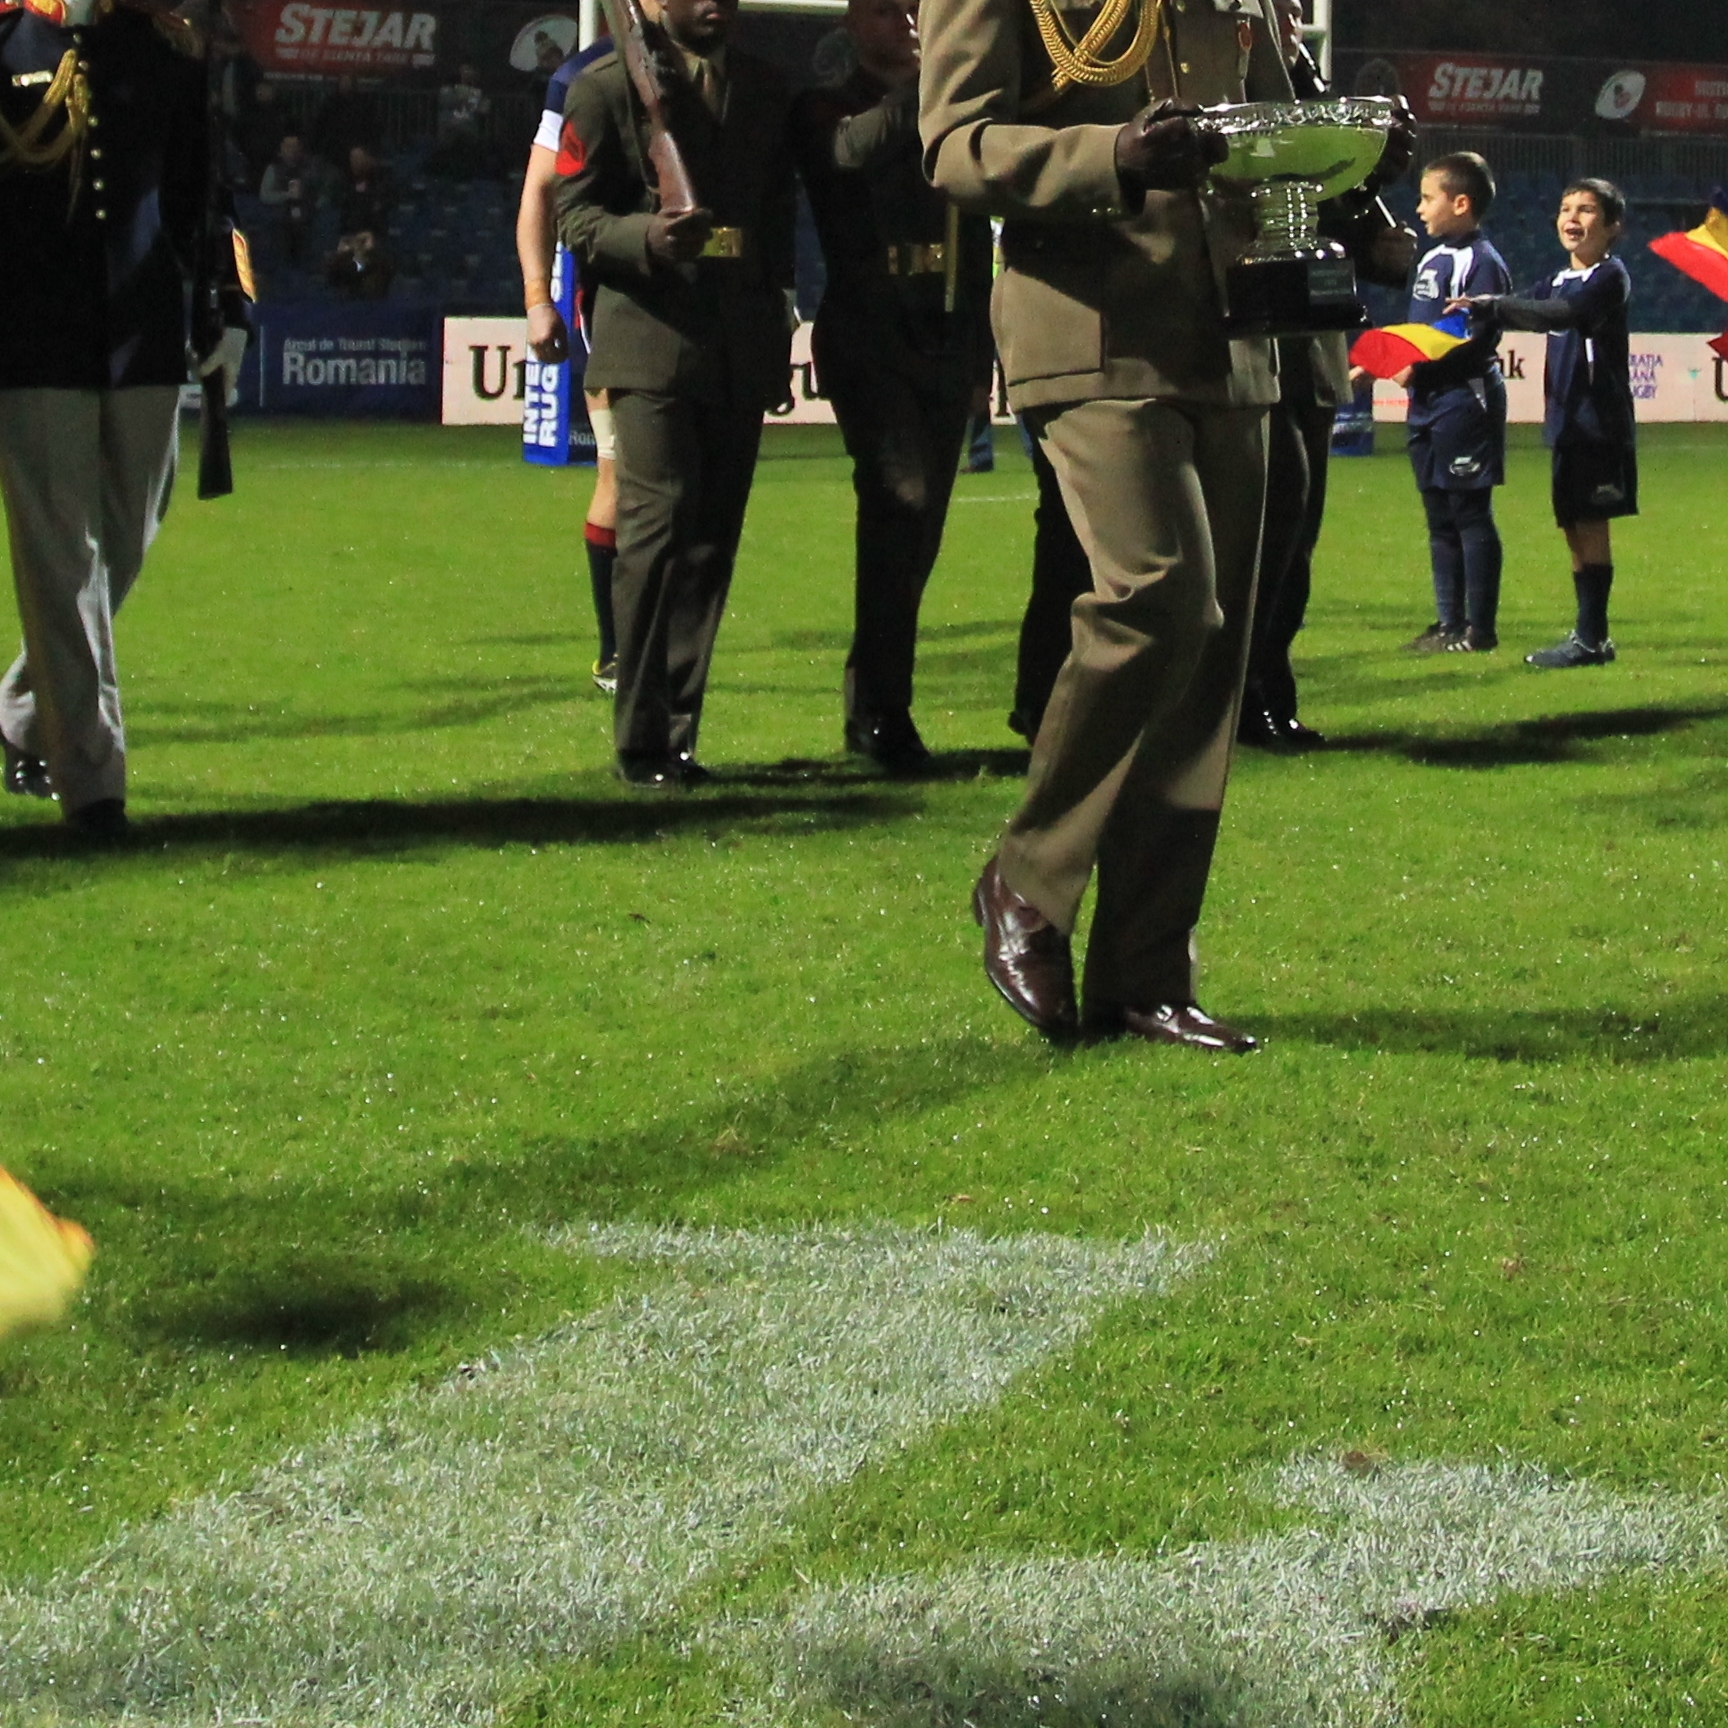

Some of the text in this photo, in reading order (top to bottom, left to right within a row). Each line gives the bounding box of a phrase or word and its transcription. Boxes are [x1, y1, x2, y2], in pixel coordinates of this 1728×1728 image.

[274, 3, 436, 50] STEJAR
[1428, 62, 1544, 101] STEJAR
[282, 351, 426, 386] Romania
